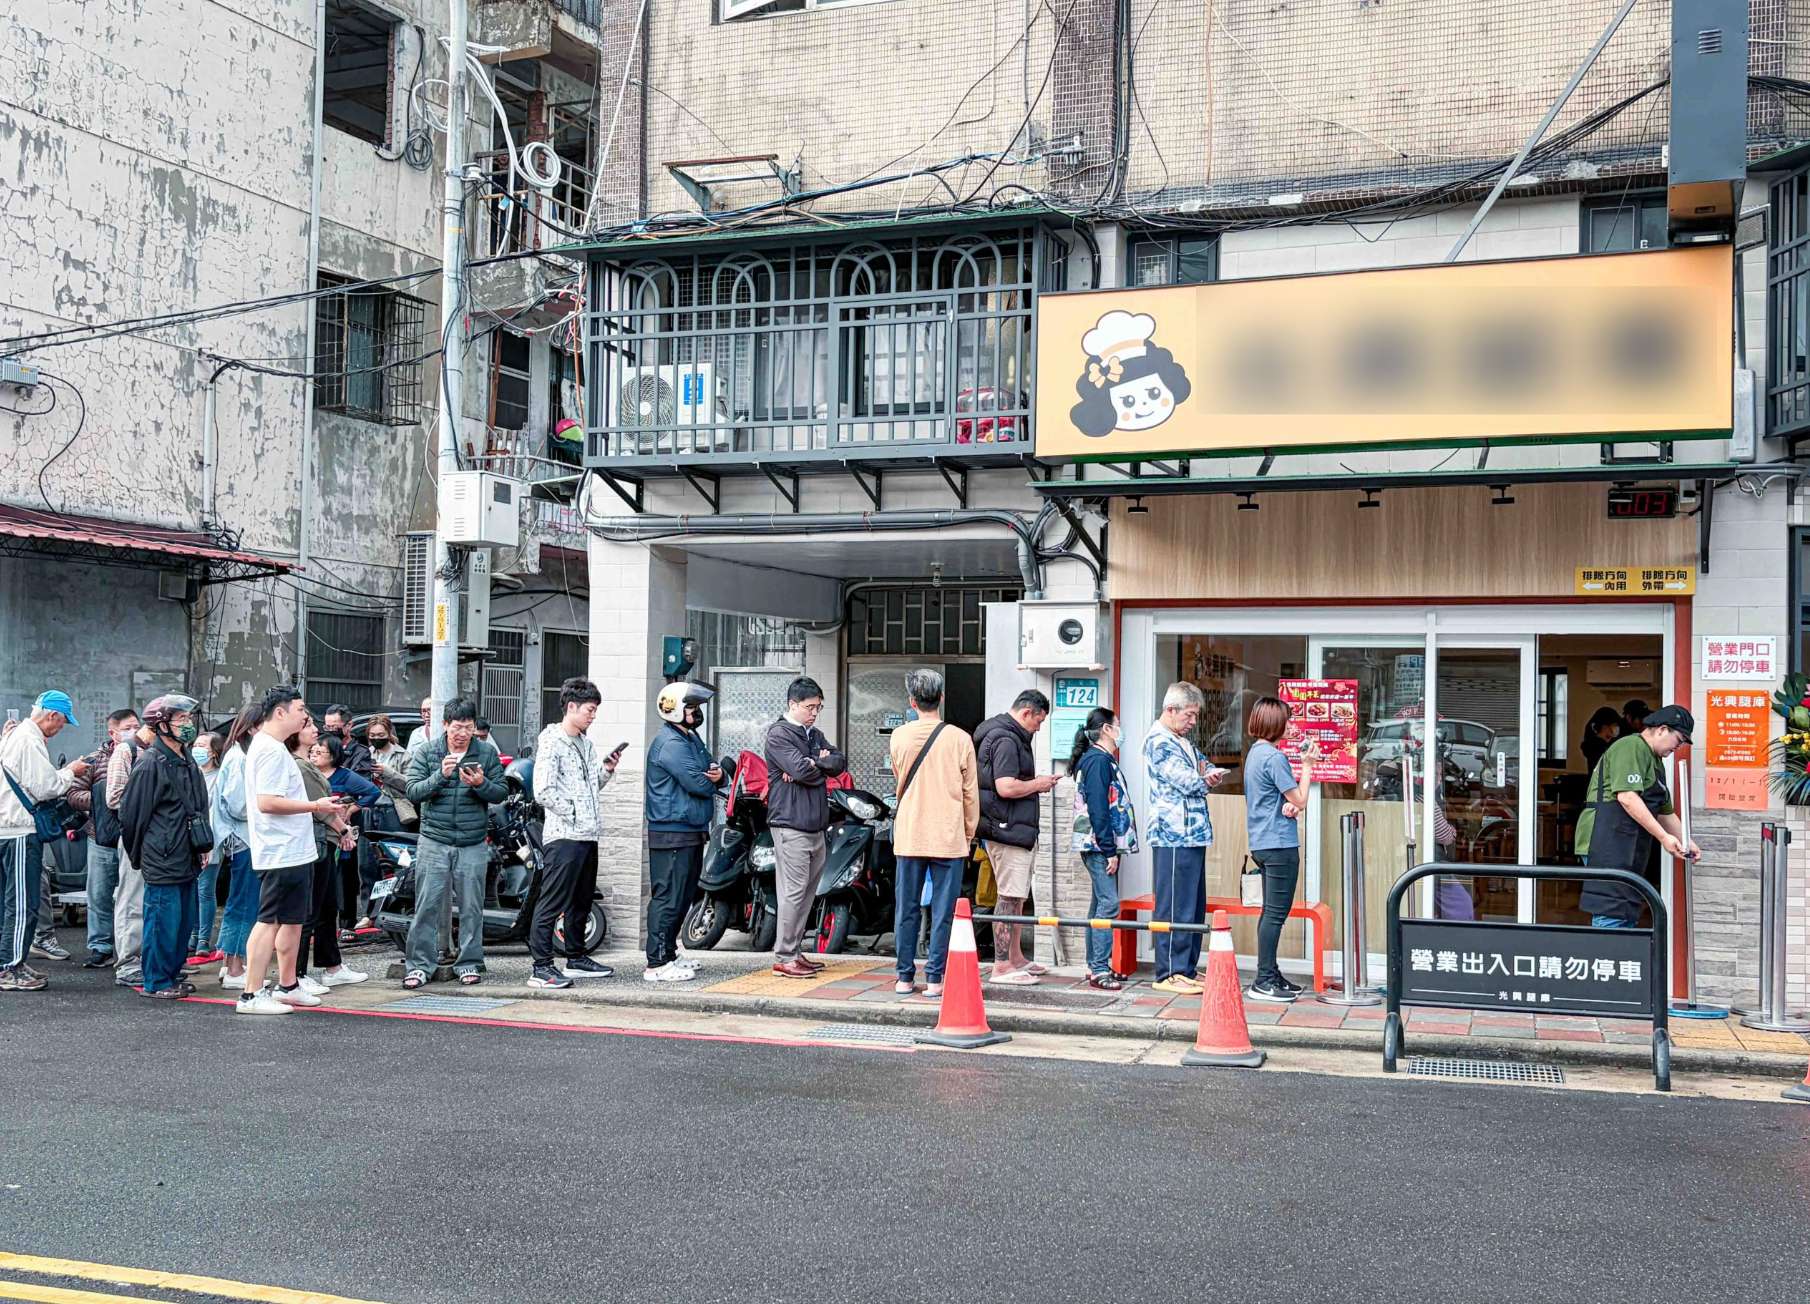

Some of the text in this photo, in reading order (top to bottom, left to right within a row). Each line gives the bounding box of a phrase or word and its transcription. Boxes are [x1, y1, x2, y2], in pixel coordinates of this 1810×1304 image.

[1582, 570, 1627, 580] 排隊方向
[1642, 570, 1687, 580] 排隊方向
[1605, 581, 1627, 591] 內用
[1642, 581, 1664, 591] 外帶
[1708, 642, 1770, 656] 營業門口
[1708, 659, 1770, 673] 請勿停車
[1069, 688, 1095, 704] 124
[1711, 695, 1766, 707] 光興腿庫
[1410, 948, 1642, 983] 營業出入口請勿停車
[1498, 990, 1551, 1003] 光興腿庫
